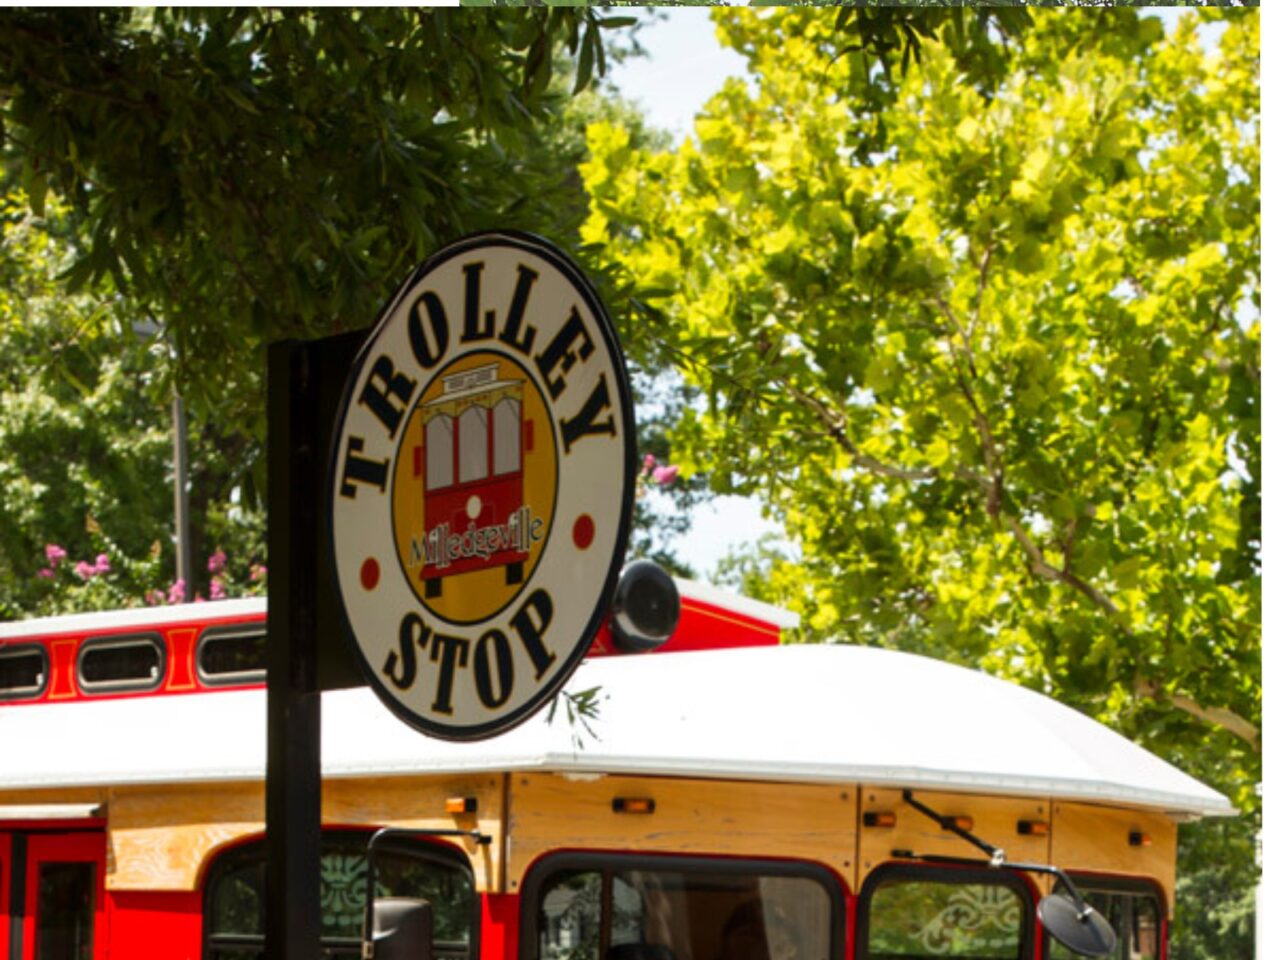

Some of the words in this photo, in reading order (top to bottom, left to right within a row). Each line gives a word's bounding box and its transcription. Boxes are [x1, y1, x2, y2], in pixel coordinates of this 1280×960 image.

[339, 260, 618, 500] TROLLEY
[408, 504, 546, 570] Milledgeville
[382, 587, 557, 716] STOP
